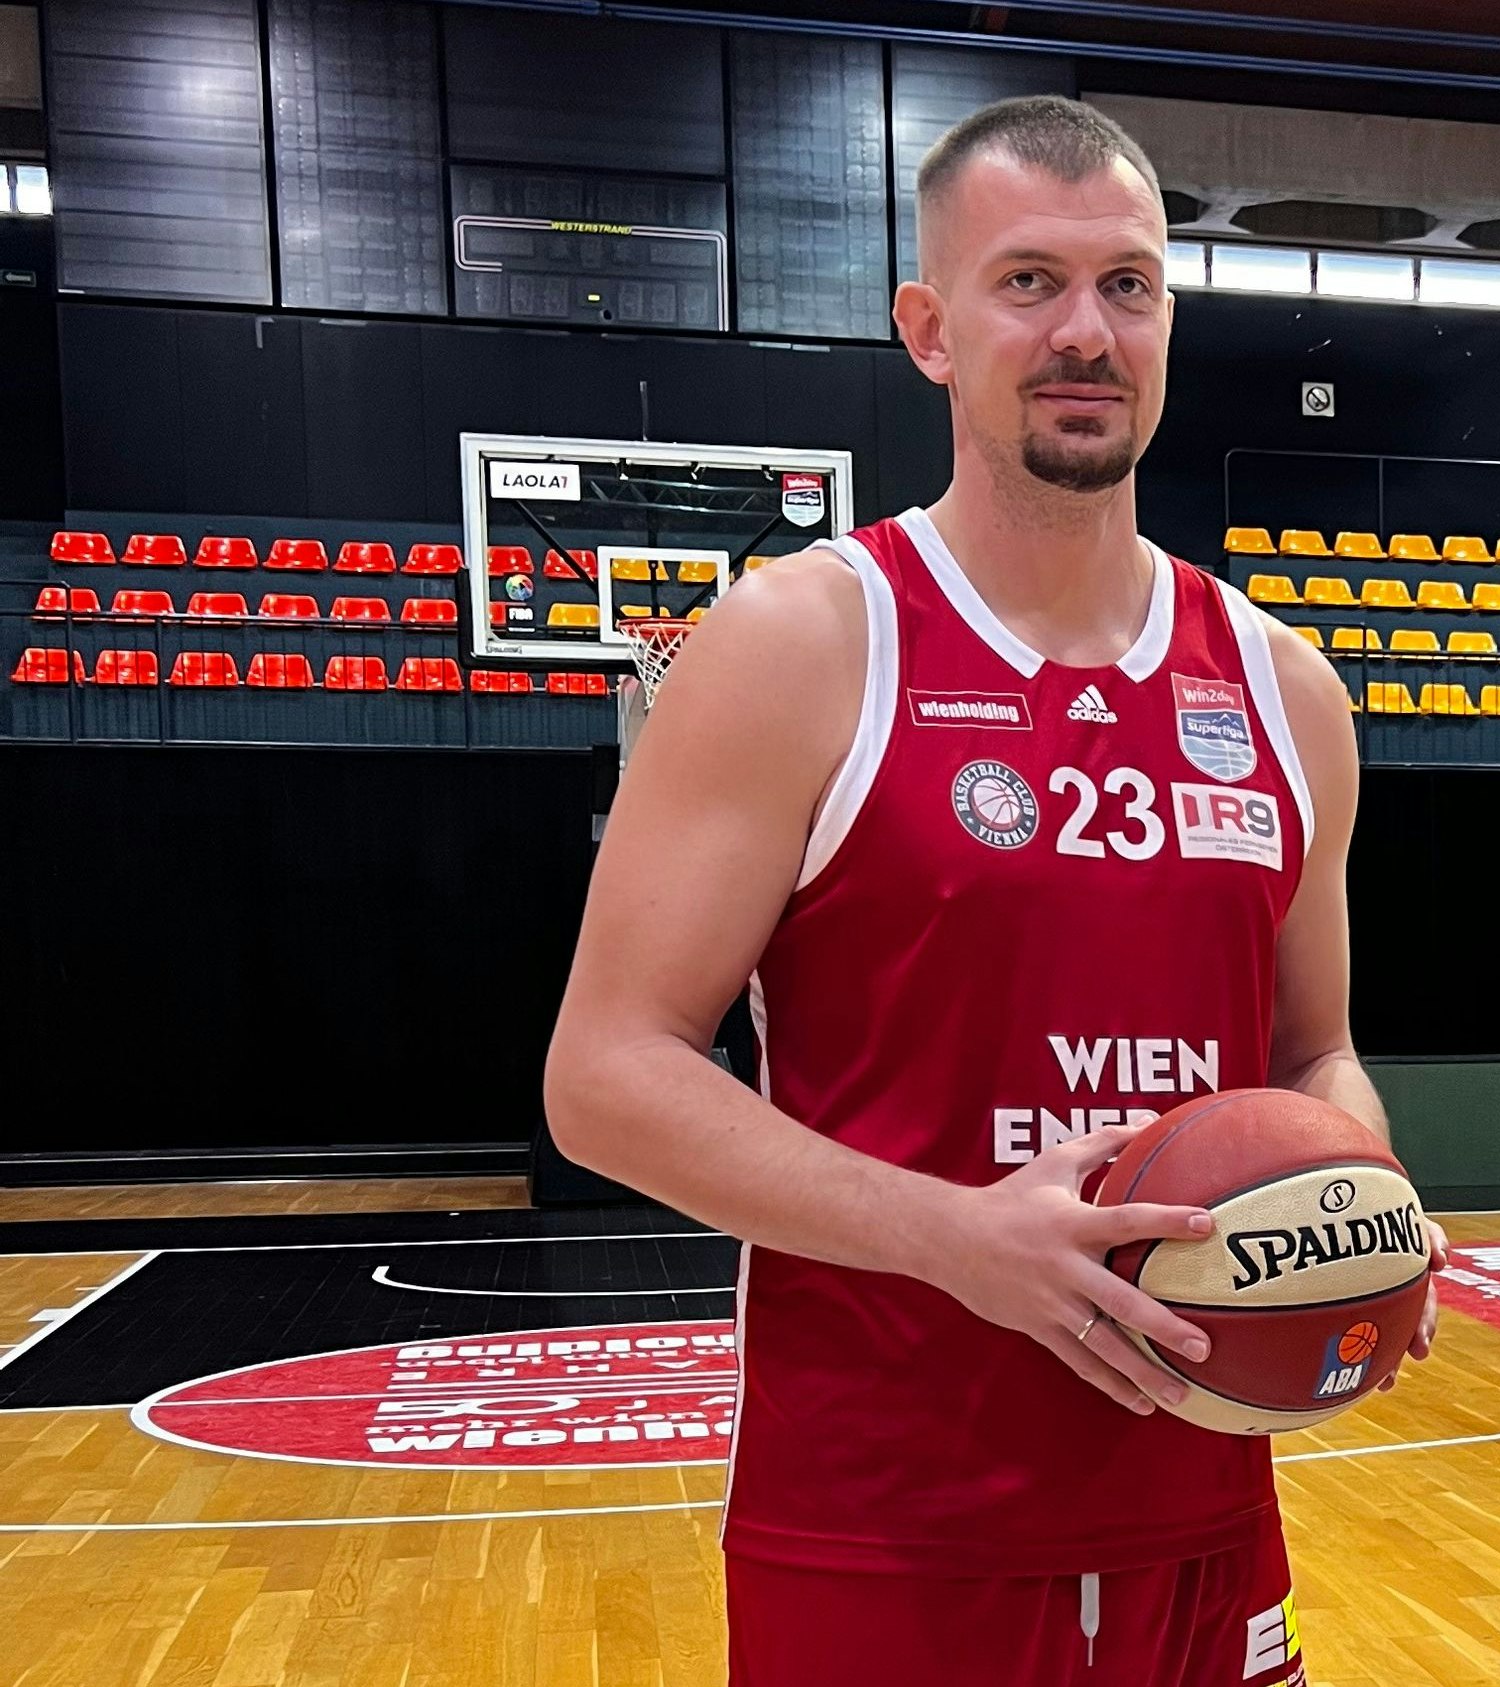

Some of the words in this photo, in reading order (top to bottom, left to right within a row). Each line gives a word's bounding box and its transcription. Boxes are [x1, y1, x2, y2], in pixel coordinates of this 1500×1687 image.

[551, 221, 632, 235] WESTERSTRAND
[503, 474, 568, 489] LAOLA1
[1067, 708, 1118, 724] adidas
[956, 764, 1011, 812] BASKETBALL
[1013, 780, 1035, 817] CLUB
[1049, 766, 1166, 861] 23
[978, 825, 1029, 845] VIENNA
[1048, 1036, 1220, 1093] WIEN
[1227, 1201, 1426, 1291] SPALDING
[1318, 1364, 1364, 1395] ABA
[373, 1397, 581, 1421] 50
